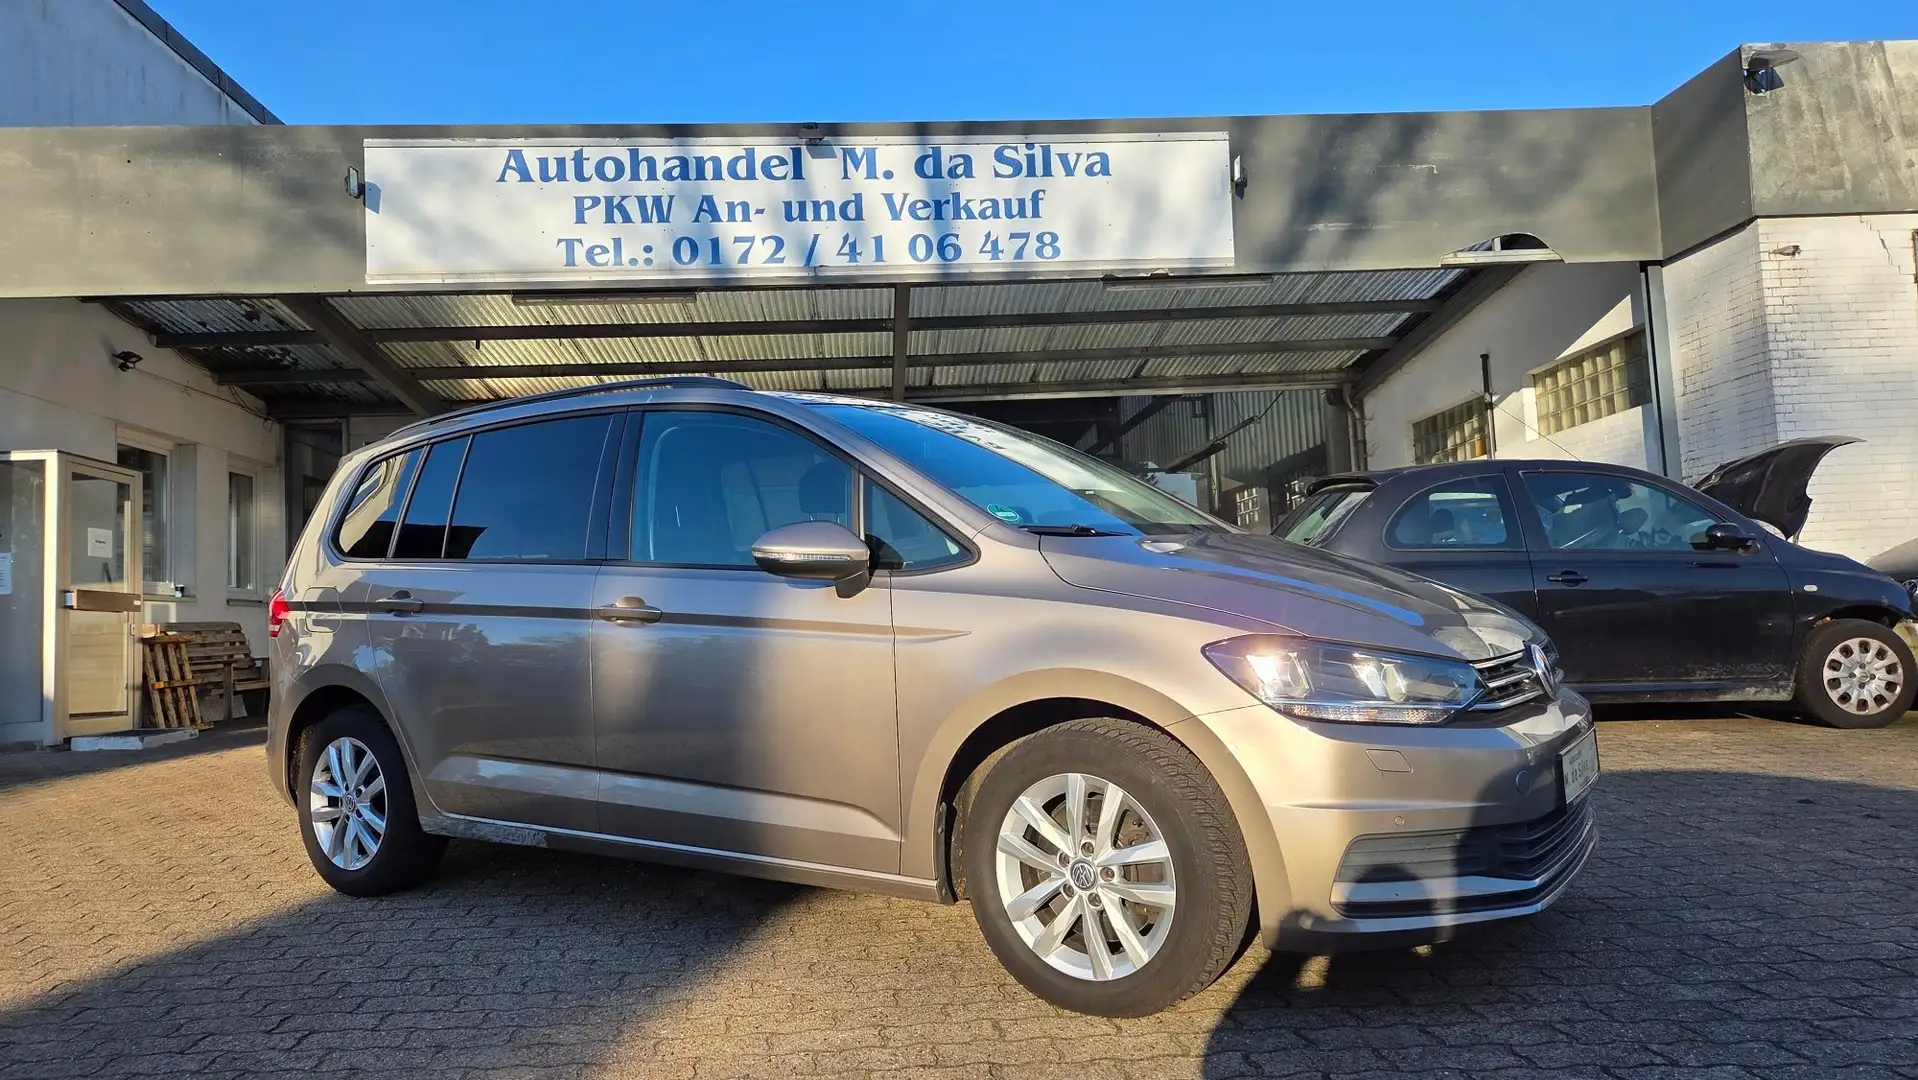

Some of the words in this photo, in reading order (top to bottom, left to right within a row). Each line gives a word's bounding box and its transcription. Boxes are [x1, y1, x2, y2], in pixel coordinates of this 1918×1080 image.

[496, 146, 805, 183] Autohandel
[840, 146, 895, 181] M.
[914, 146, 974, 180] da
[992, 143, 1112, 179] Silva
[573, 194, 675, 225] PKW
[692, 194, 767, 224] An-
[781, 192, 865, 222] und
[881, 189, 1046, 221] Verkauf
[556, 236, 654, 268] Tel.:
[672, 235, 786, 266] 0172
[803, 233, 821, 268] /
[836, 231, 885, 263] 41
[908, 231, 962, 262] 06
[979, 231, 1061, 261] 478
